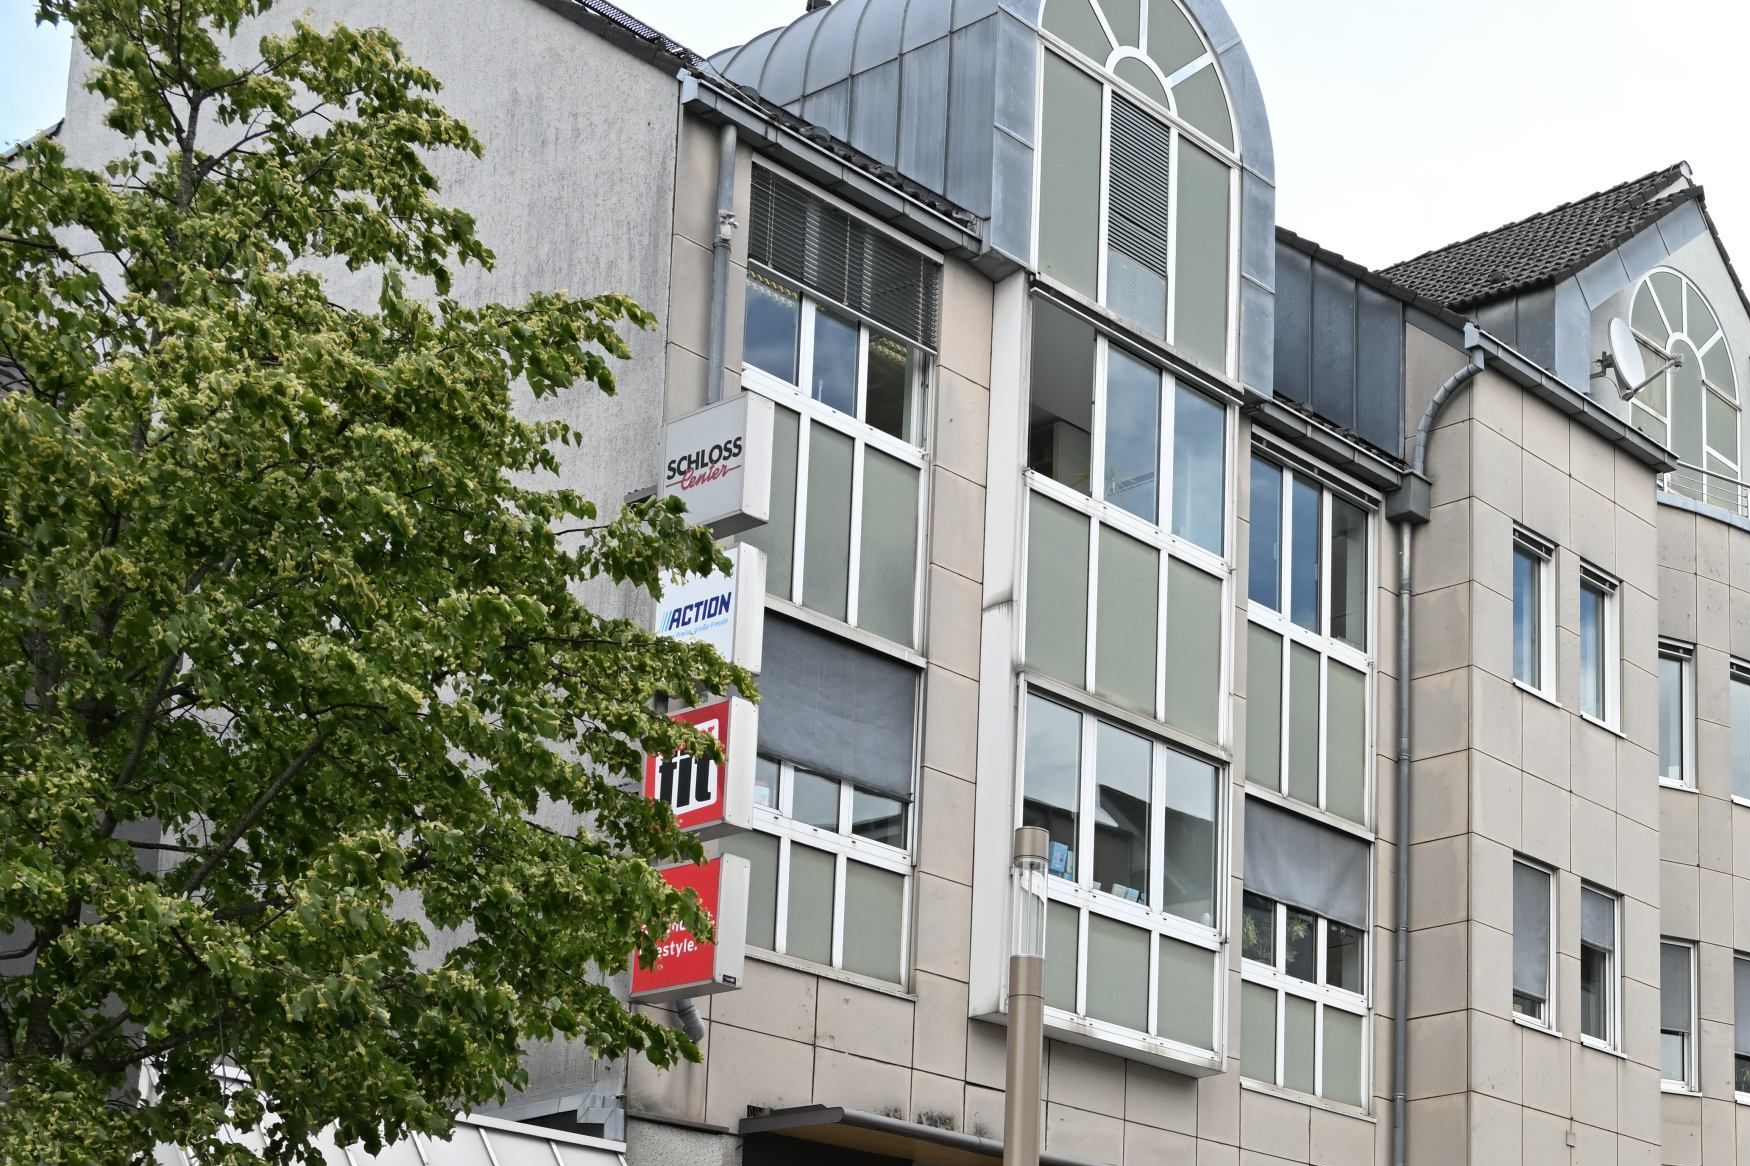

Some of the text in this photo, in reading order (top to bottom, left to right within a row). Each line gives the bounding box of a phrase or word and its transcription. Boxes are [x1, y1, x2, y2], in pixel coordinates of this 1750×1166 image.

[667, 436, 742, 480] SCHLOSS
[669, 464, 737, 490] Center
[668, 592, 731, 630] ACTION
